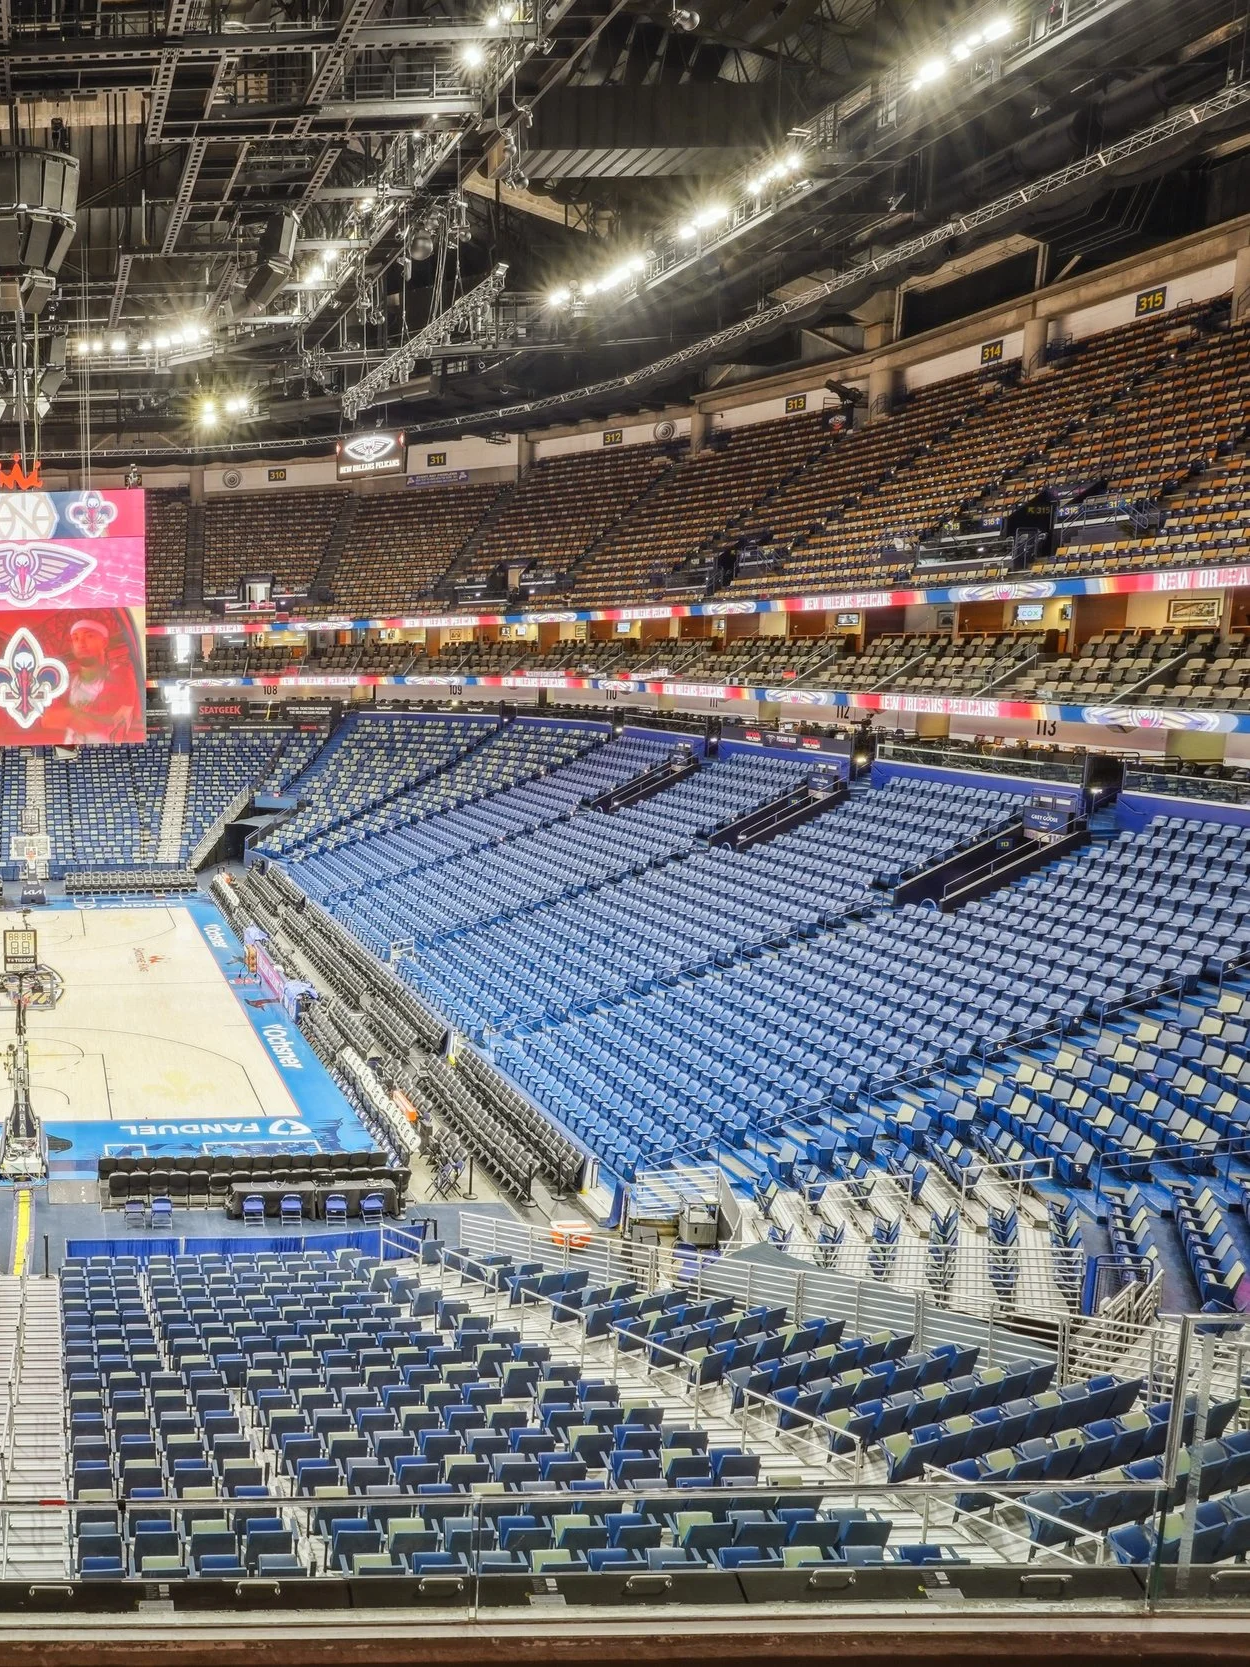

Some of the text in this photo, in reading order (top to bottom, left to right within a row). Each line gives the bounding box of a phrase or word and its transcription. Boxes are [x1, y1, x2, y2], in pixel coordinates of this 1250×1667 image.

[1138, 292, 1163, 312] 315
[983, 345, 1001, 360] 314
[787, 398, 805, 410] 313
[605, 432, 621, 443] 312
[340, 459, 400, 474] NEW ORLEANS PELICANS
[430, 455, 444, 464] 311
[269, 471, 285, 479] 310
[1159, 571, 1190, 589] NEW
[804, 593, 892, 609] NEW ORLEANS PELICANS
[1022, 610, 1039, 618] COX
[167, 625, 244, 635] NEW ORLEANS PELICANS
[263, 685, 278, 695] 108
[449, 685, 462, 695] 109
[199, 705, 241, 715] SEATGEEK
[837, 705, 850, 719] 112
[882, 696, 995, 717] NEW ORLEANS PELICANS
[1036, 720, 1056, 736] 113
[1031, 813, 1059, 823] GREY GOOSE
[262, 1029, 304, 1069] Ochsner
[18, 1104, 27, 1132] NBA
[119, 1121, 261, 1136] FANDUEL
